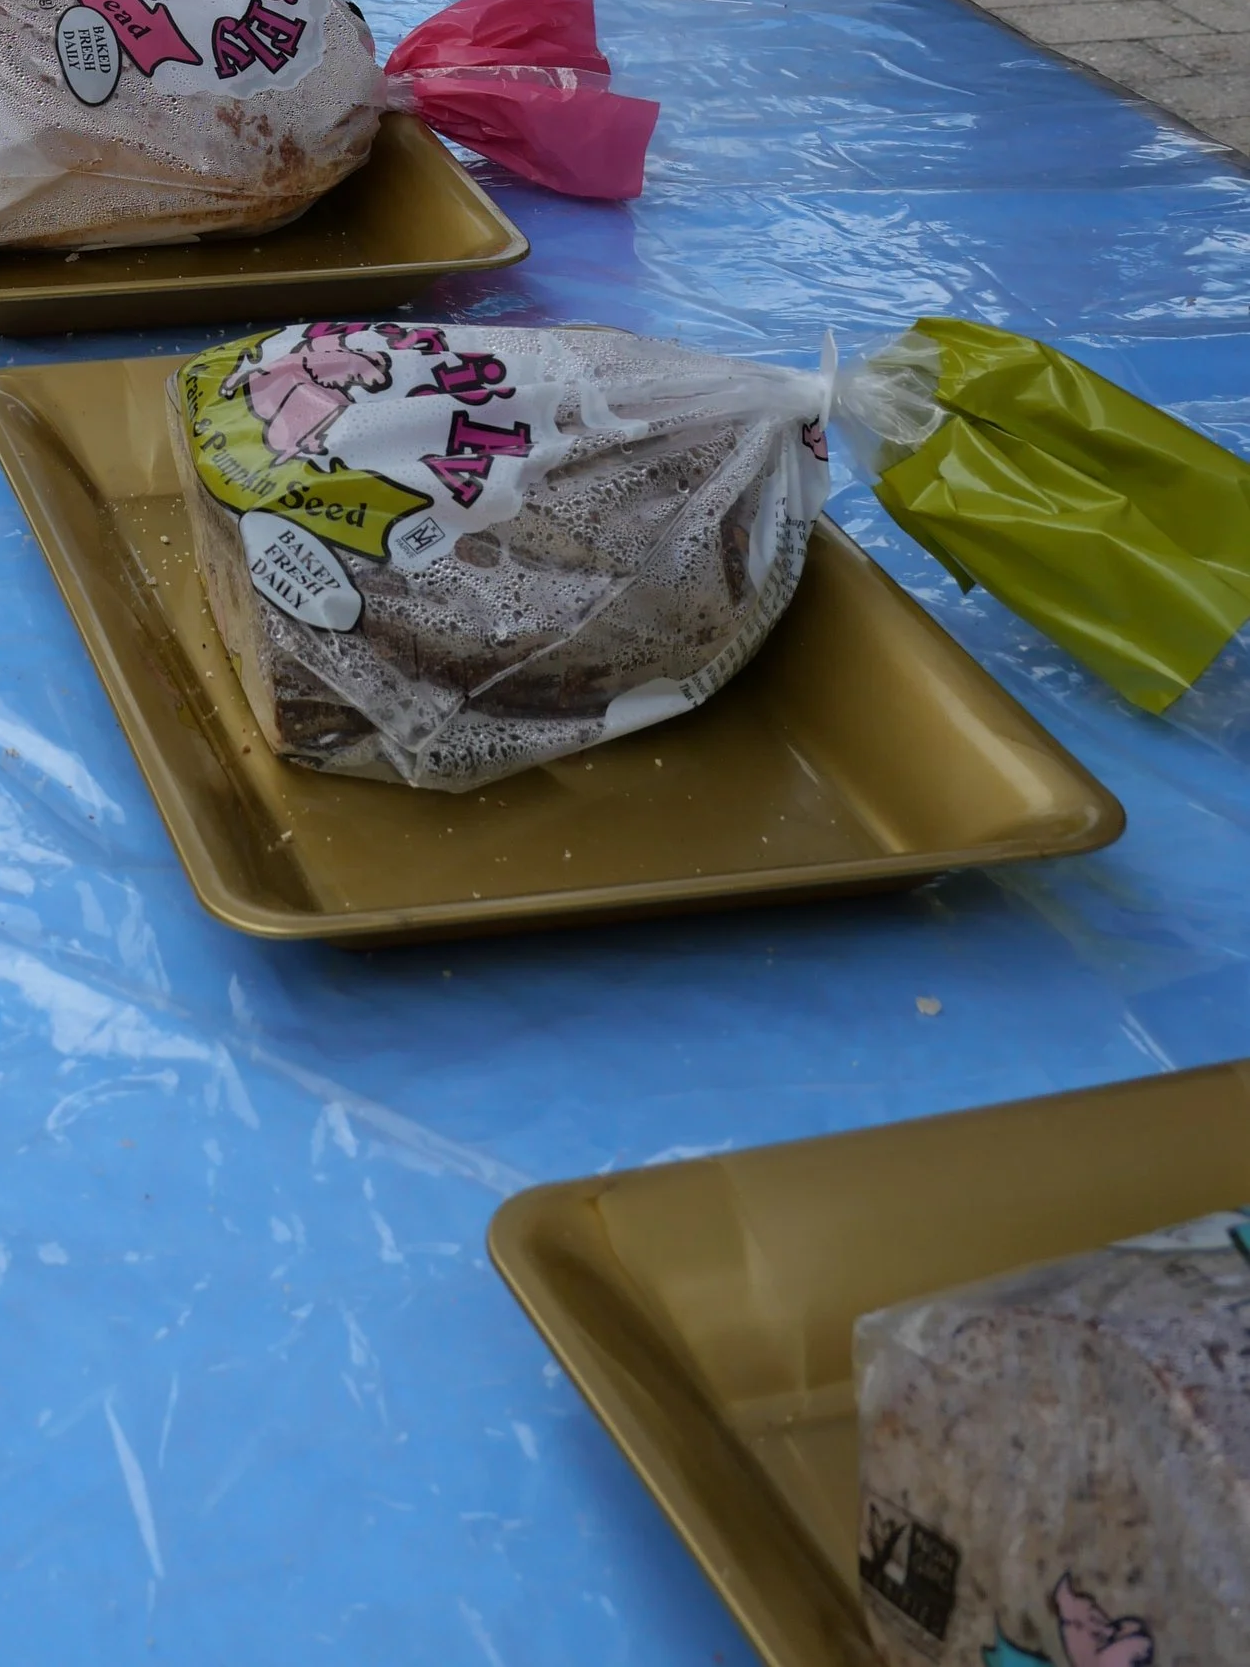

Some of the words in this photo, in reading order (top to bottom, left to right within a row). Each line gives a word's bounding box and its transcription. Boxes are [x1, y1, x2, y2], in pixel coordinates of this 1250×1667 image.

[62, 30, 81, 72] DAILY
[78, 29, 96, 72] FRESH
[92, 25, 111, 74] BAKED
[212, 0, 307, 80] Fly
[202, 430, 279, 499] Pumpkin
[279, 481, 367, 529] Seed
[250, 555, 306, 612] DAILY
[264, 543, 323, 598] FRESH
